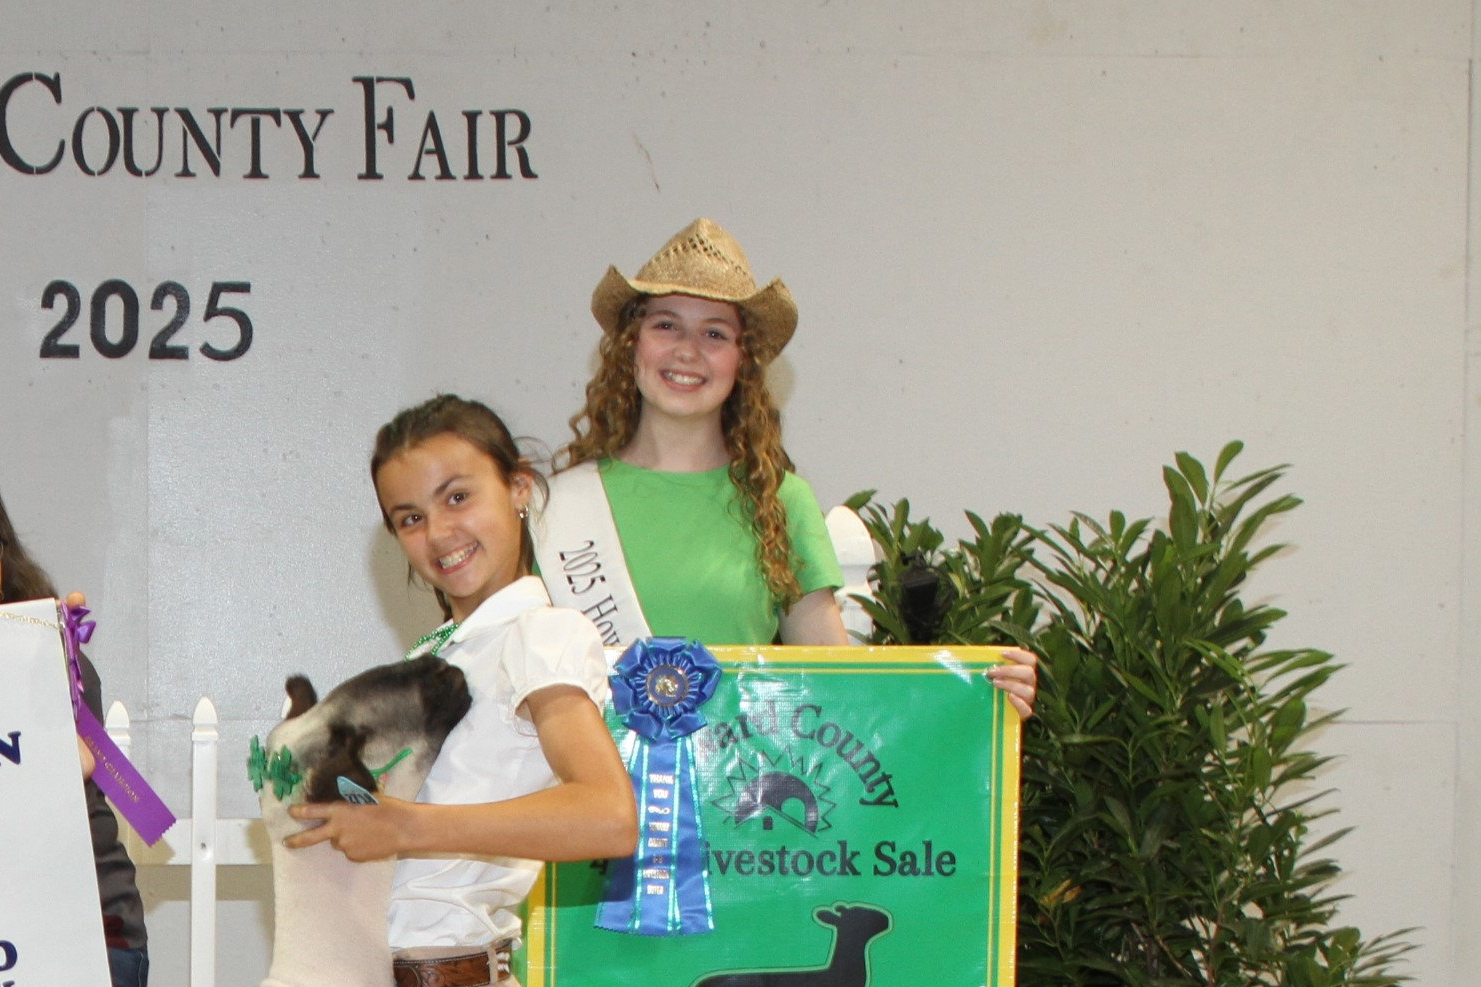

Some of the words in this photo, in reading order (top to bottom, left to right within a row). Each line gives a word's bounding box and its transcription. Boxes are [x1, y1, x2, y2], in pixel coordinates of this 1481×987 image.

[352, 76, 538, 180] FAIR
[40, 280, 252, 361] 2025
[559, 540, 606, 595] 2025
[791, 703, 899, 808] County
[653, 789, 668, 799] YOU
[873, 840, 957, 877] Sale
